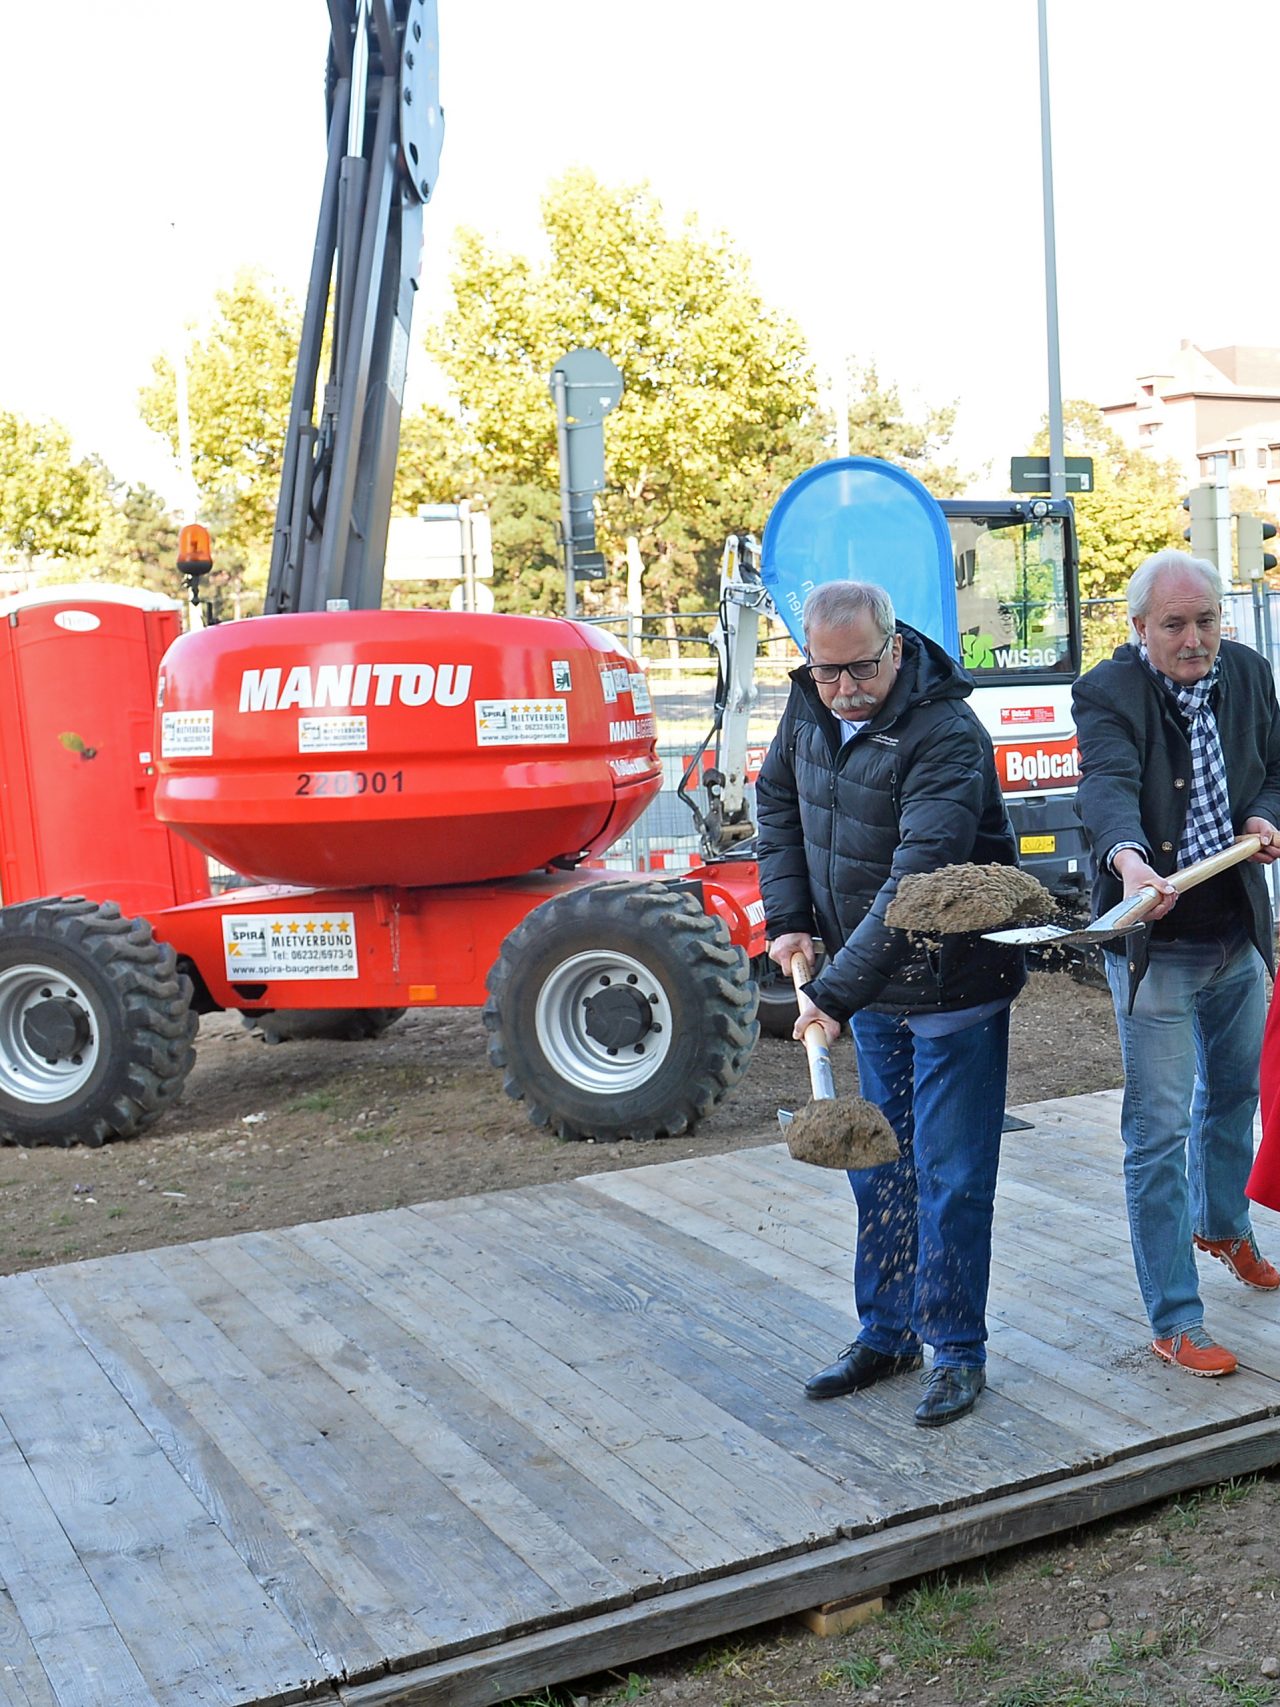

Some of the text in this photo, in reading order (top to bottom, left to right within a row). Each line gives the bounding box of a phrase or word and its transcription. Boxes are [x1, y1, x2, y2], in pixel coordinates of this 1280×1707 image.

[238, 663, 473, 713] MANITOU
[295, 770, 403, 796] 220001
[232, 931, 266, 941] SPIRA
[271, 935, 353, 948] MIETVERBUND
[232, 963, 354, 975] www.spira-baugeraete.de
